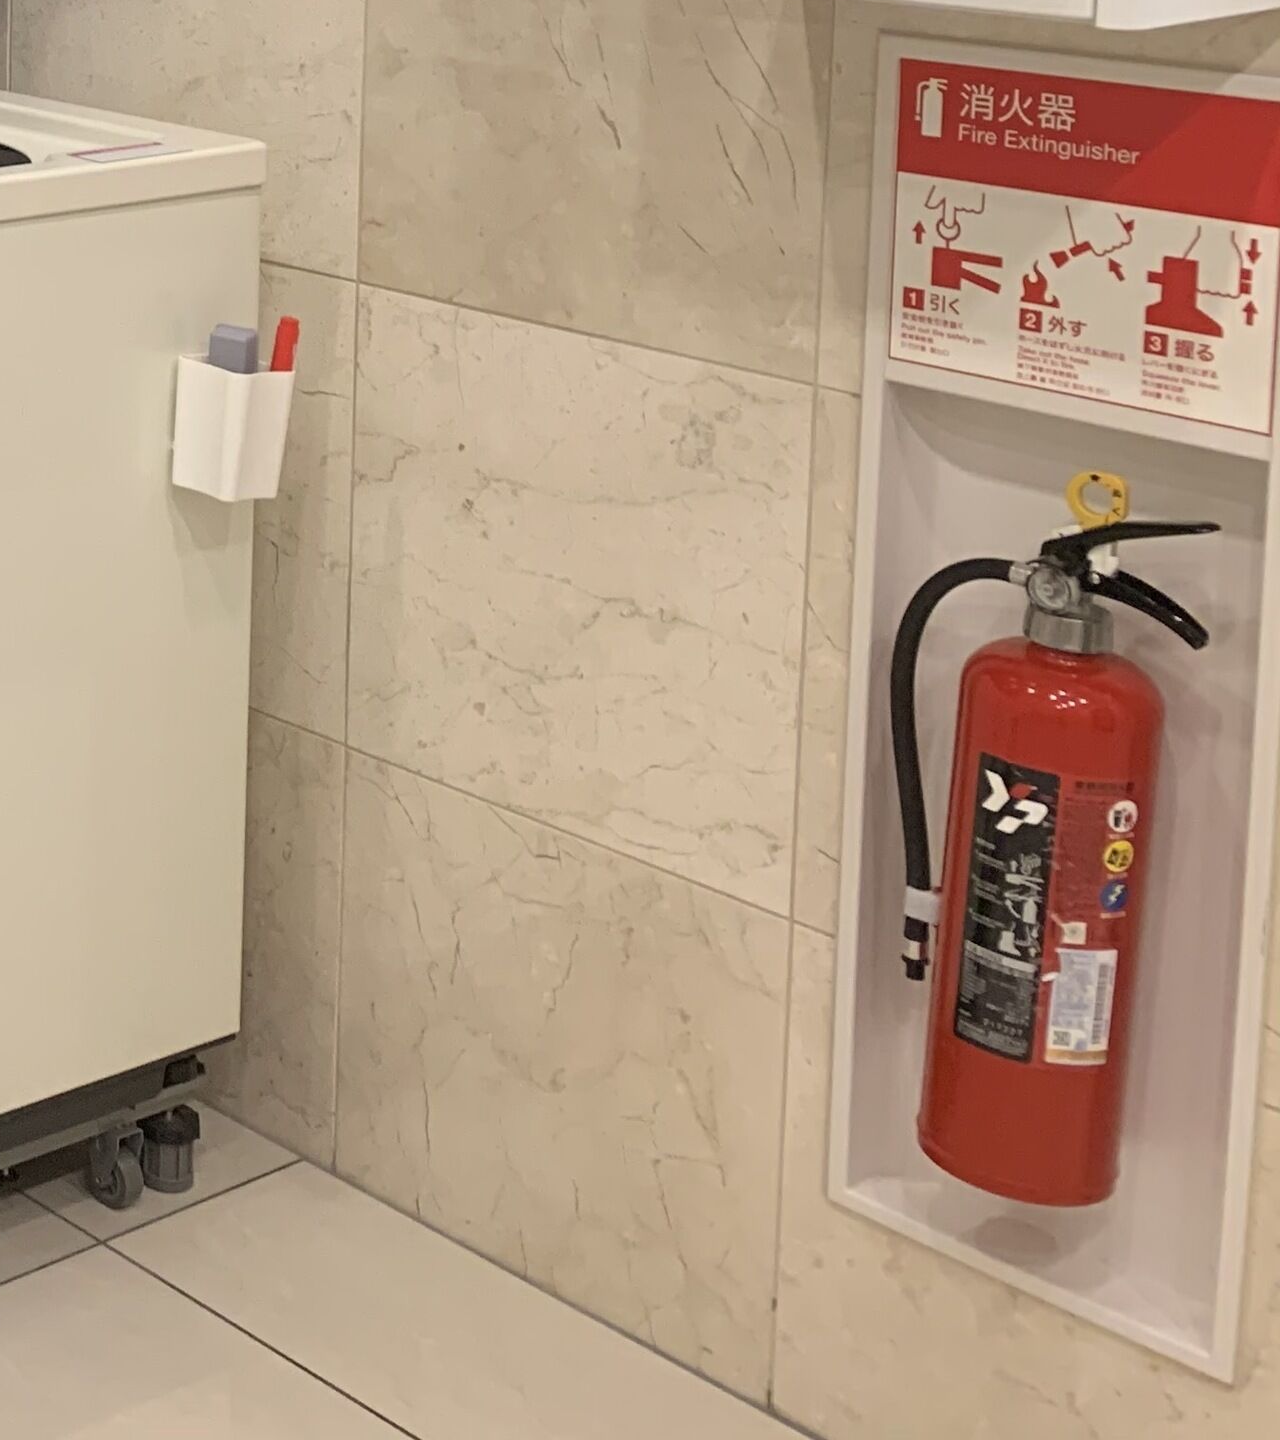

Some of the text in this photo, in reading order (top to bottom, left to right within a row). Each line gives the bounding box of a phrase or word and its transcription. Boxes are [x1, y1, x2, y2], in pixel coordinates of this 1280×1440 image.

[960, 82, 1077, 133] 消火器
[957, 122, 1141, 165] Fire Extinguisher
[908, 290, 961, 316] 1 引く
[1024, 312, 1088, 338] 2 外す
[1148, 335, 1215, 362] 3 握る
